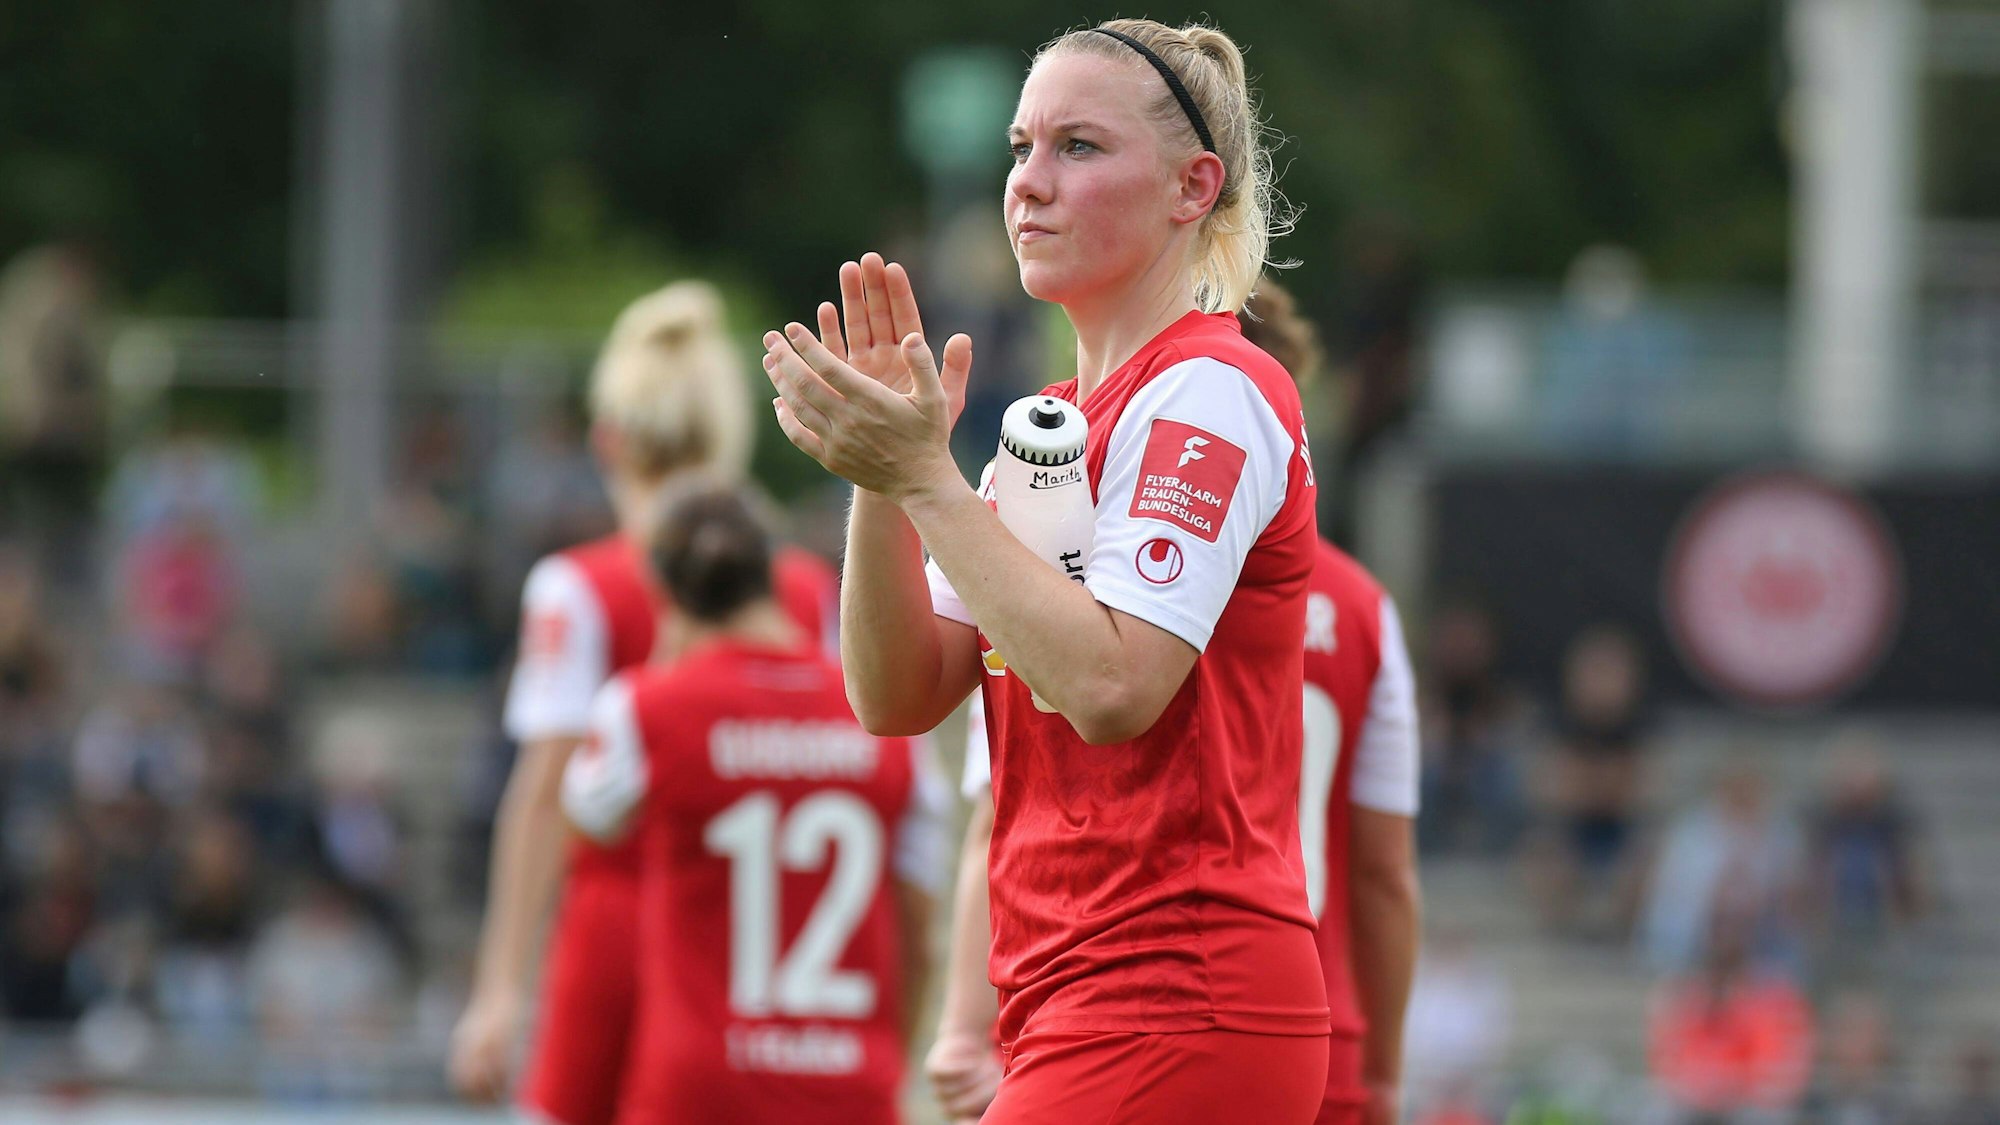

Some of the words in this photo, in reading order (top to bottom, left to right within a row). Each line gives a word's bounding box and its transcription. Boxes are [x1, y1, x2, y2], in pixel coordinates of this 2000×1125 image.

[1032, 466, 1081, 487] Marith
[1145, 474, 1222, 508] FLYERALARM
[1141, 487, 1194, 507] FRAUEN-
[1137, 499, 1212, 533] BUNDESLIGA
[703, 788, 886, 1019] 12
